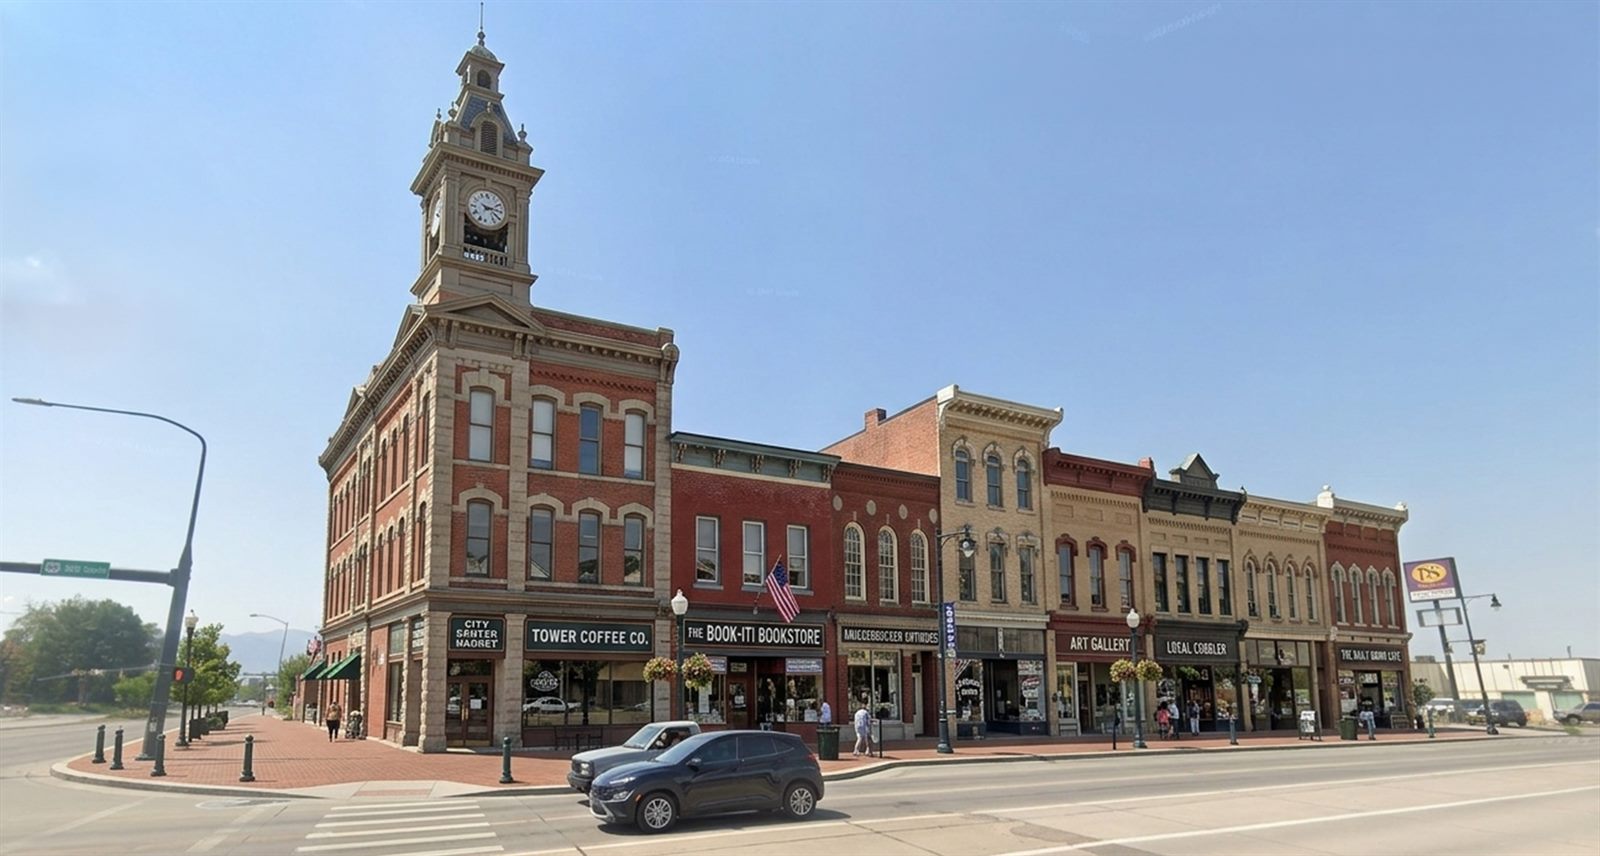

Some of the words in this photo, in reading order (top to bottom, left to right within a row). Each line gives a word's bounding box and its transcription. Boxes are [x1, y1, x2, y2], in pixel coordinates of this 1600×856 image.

[464, 619, 490, 629] CITY
[531, 628, 577, 644] TOWER
[580, 630, 627, 645] COFFEE
[629, 631, 649, 645] CO.
[758, 626, 821, 645] BOOKSTORE
[1070, 636, 1089, 650] ART
[1090, 636, 1131, 652] GALLERY
